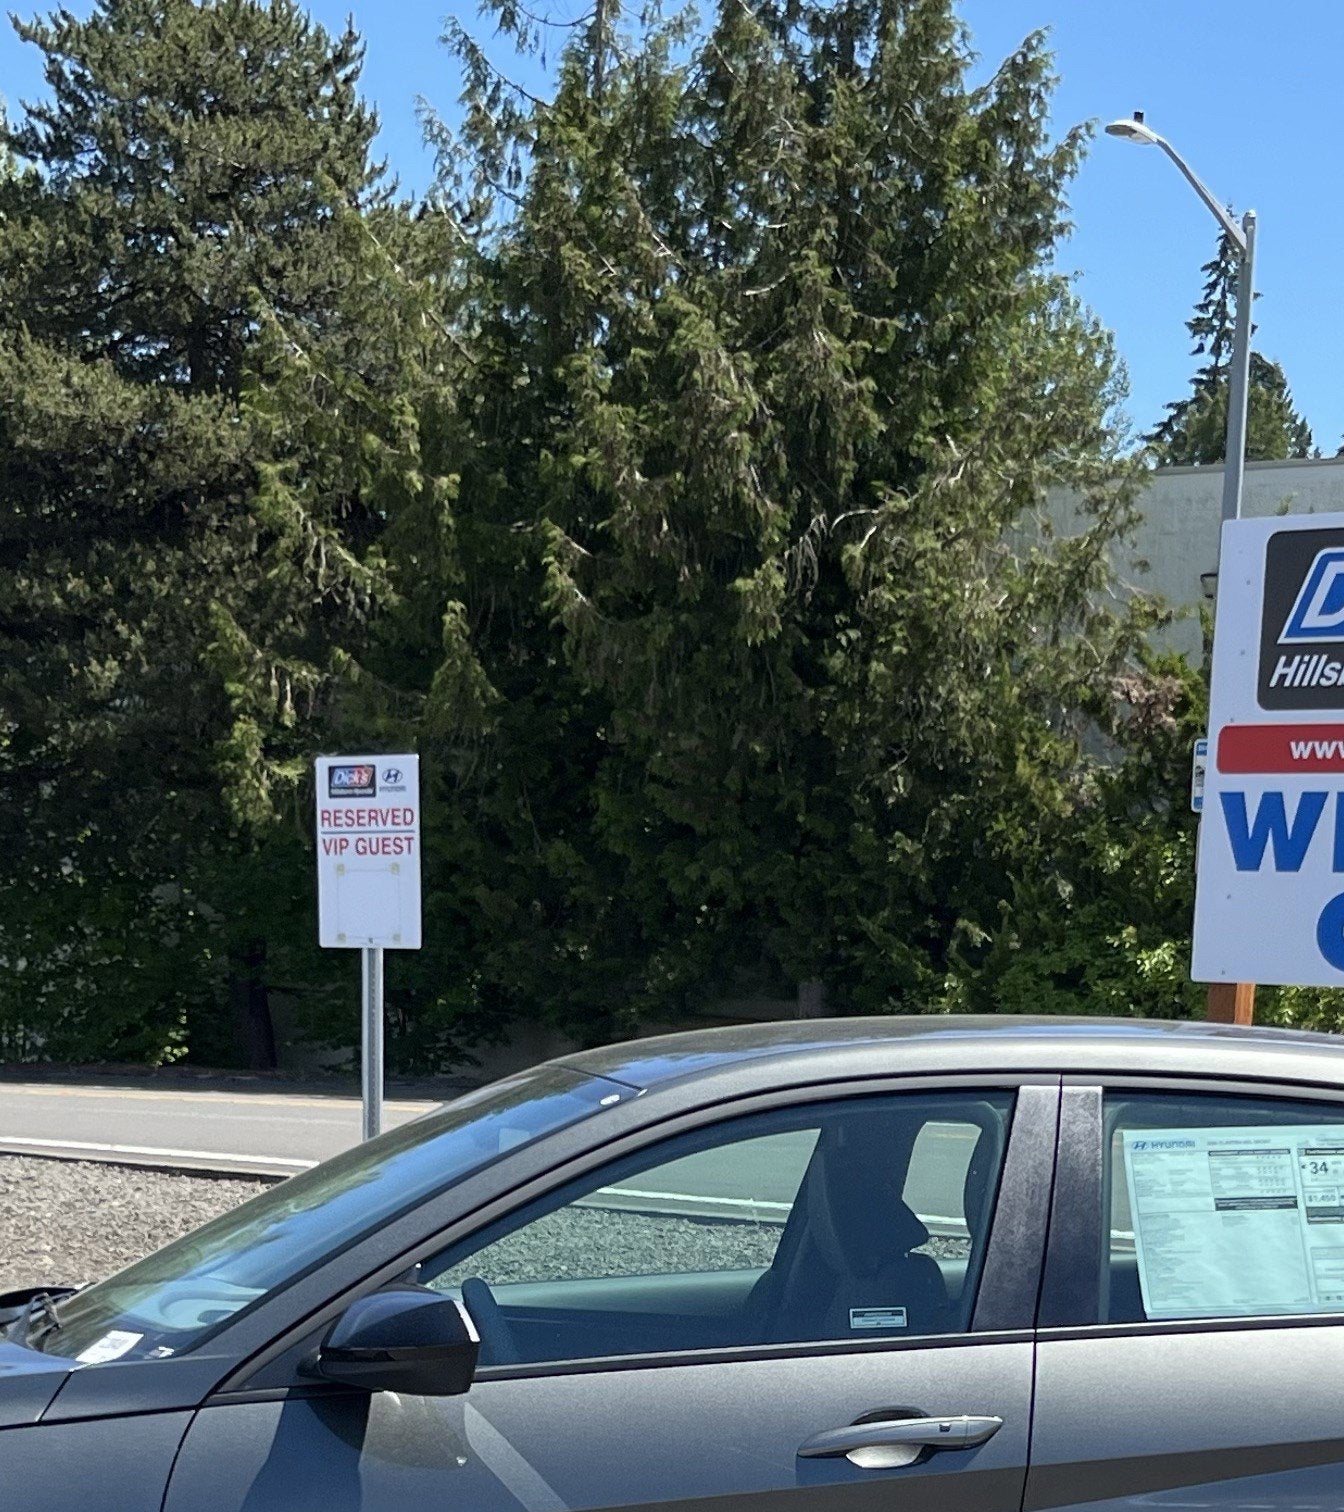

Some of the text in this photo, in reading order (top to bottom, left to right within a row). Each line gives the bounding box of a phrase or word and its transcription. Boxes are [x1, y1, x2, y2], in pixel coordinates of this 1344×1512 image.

[321, 808, 415, 828] RESERVED
[322, 837, 415, 856] VIP GUEST
[1309, 1161, 1328, 1175] 34
